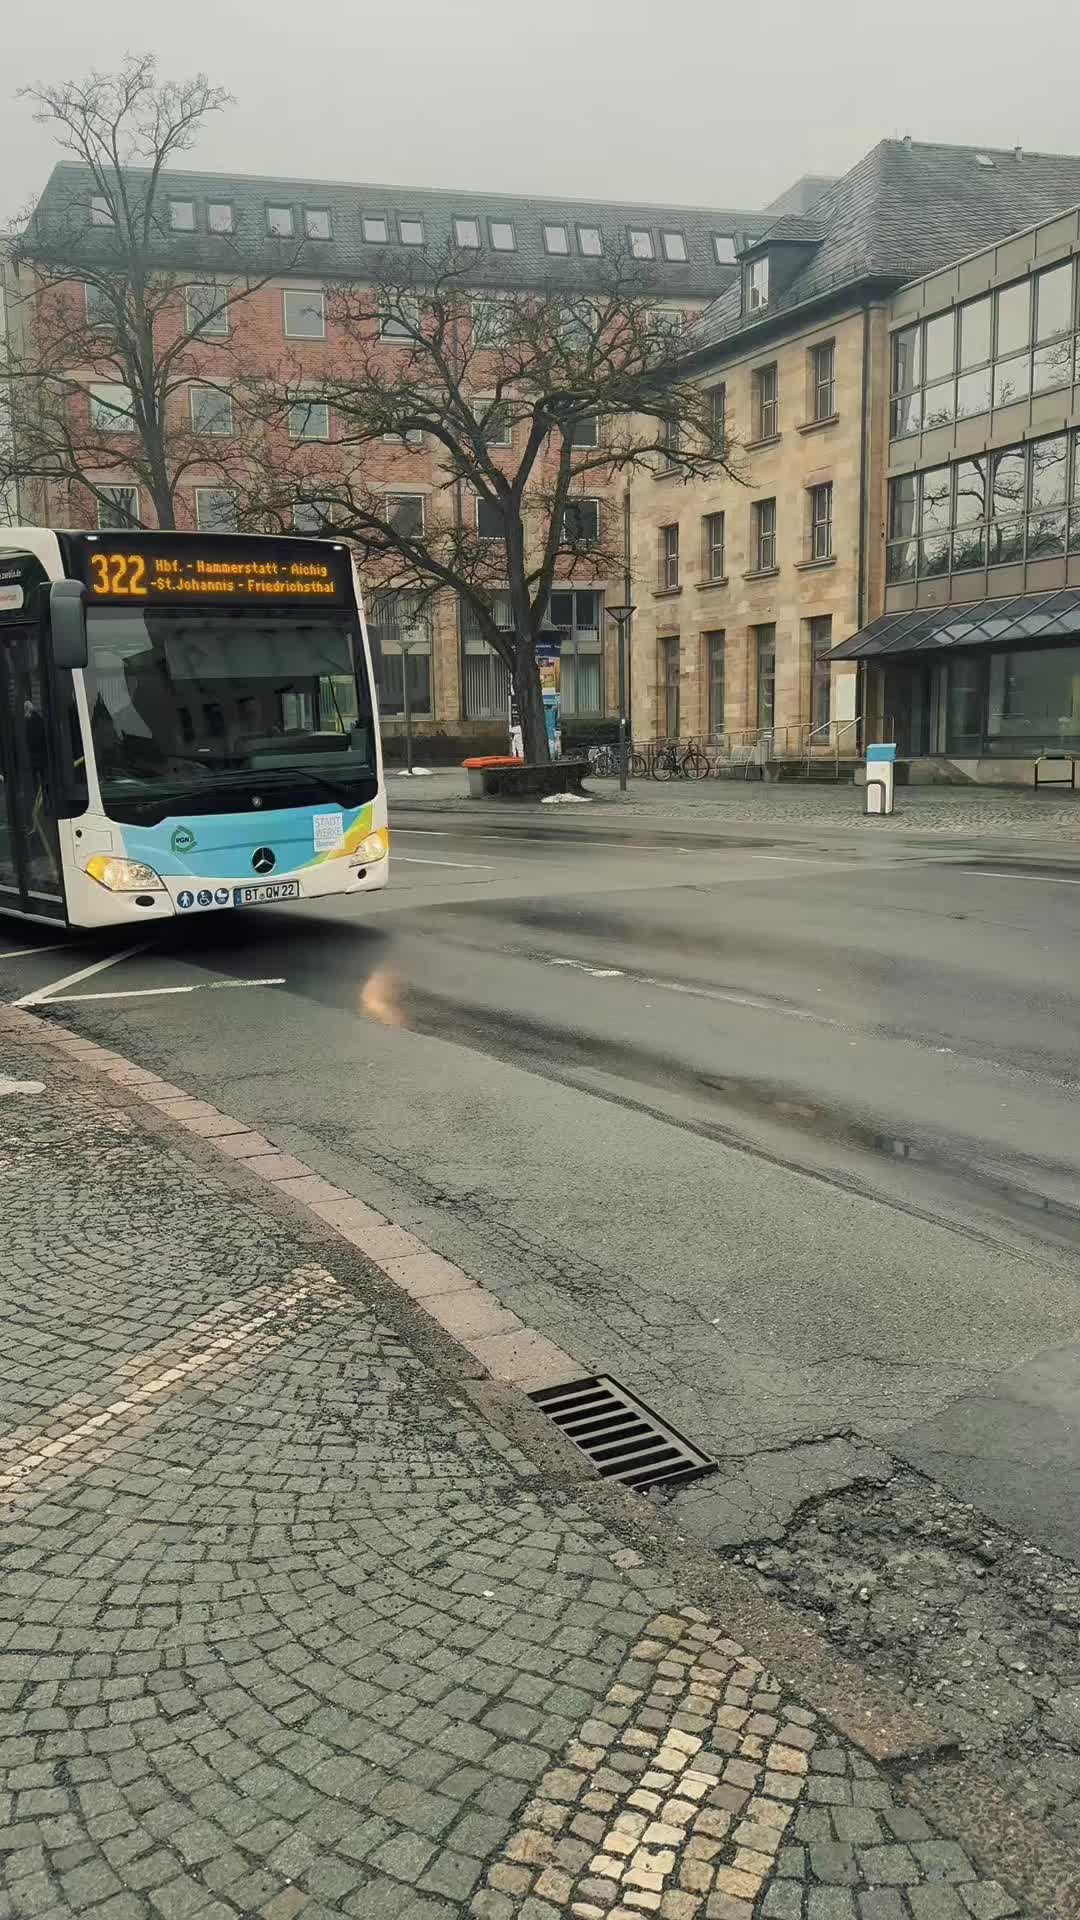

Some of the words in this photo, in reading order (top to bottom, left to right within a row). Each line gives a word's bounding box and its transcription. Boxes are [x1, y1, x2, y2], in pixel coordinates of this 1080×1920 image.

[91, 554, 147, 594] 322
[155, 560, 183, 572] Hbf.
[196, 560, 278, 574] Hammerstatt
[291, 563, 328, 577] Aichig
[247, 580, 335, 593] Friedrichsthal
[245, 888, 259, 901] BT
[265, 886, 280, 899] QW
[282, 884, 295, 897] 22
